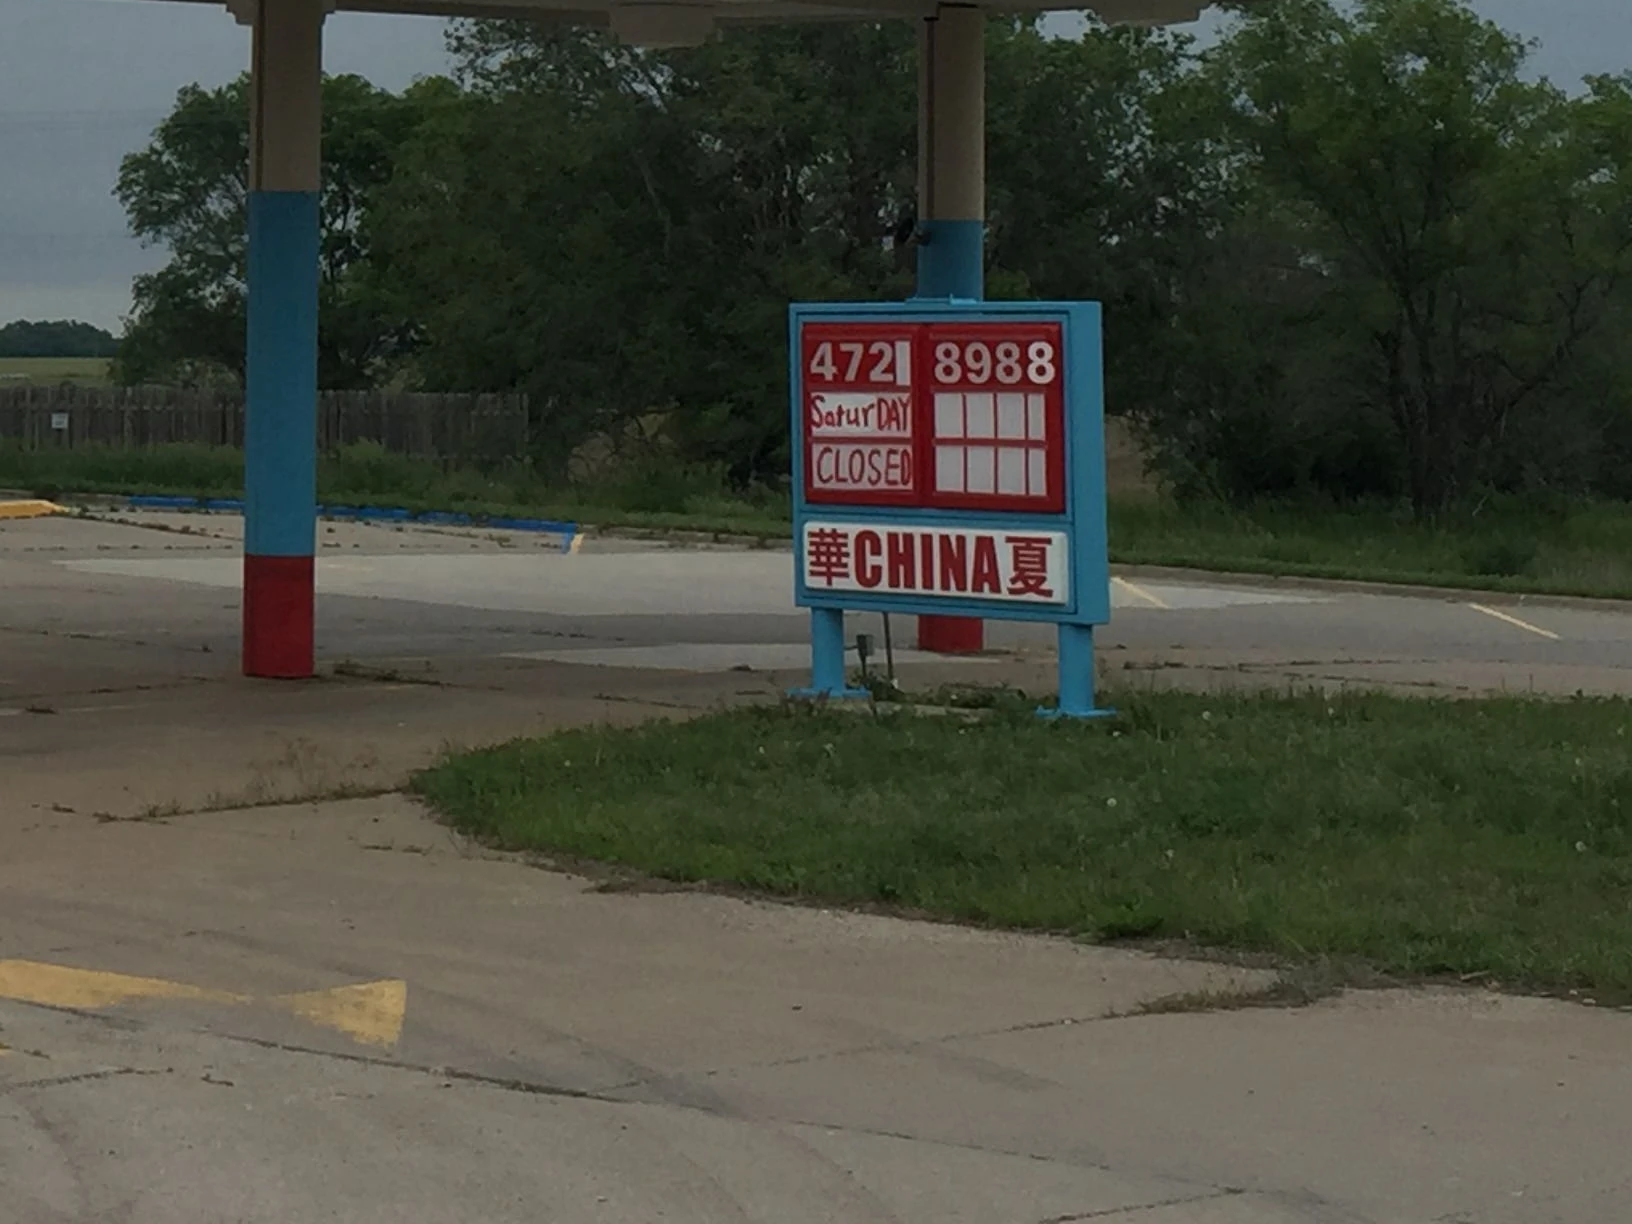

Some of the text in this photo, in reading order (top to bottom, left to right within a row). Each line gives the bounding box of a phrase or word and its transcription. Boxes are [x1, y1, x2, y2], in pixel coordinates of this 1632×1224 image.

[934, 341, 1056, 385] 8988
[817, 446, 912, 486] CLOSED
[807, 528, 1054, 598] 華 CHINA 夏
